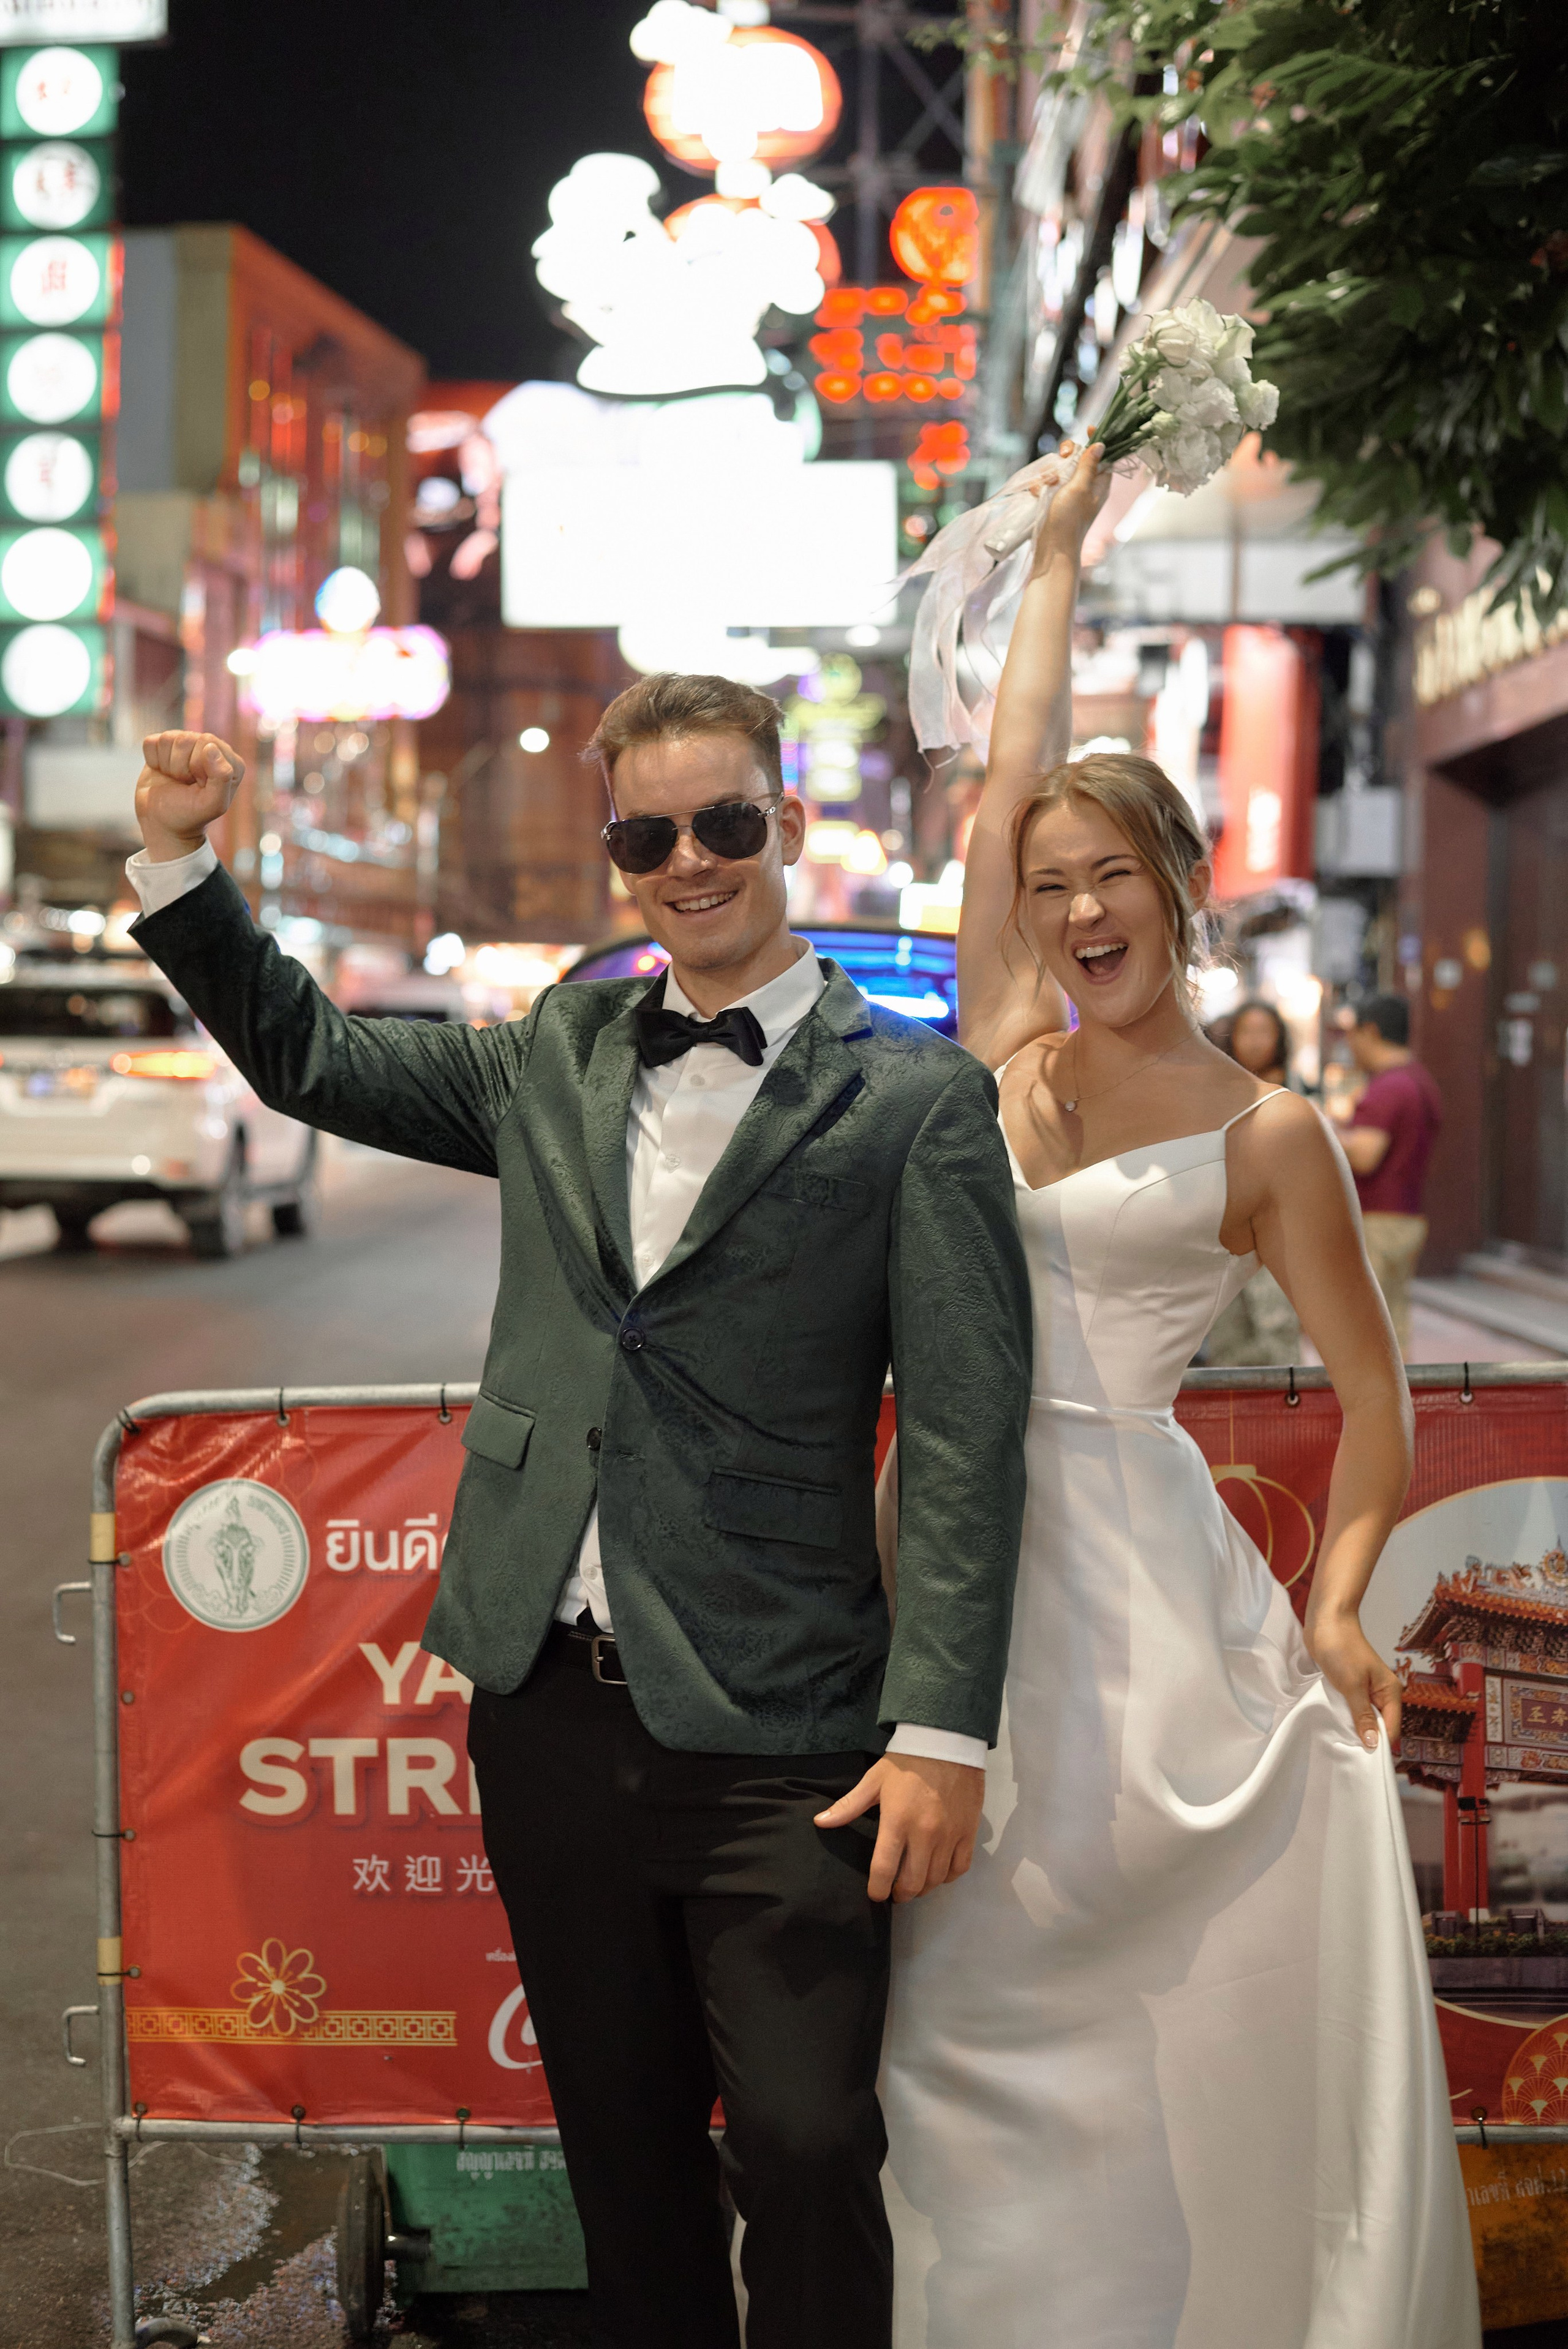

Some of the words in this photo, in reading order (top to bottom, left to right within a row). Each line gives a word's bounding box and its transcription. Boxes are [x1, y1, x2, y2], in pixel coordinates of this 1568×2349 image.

[326, 1513, 448, 1572] ยินดี
[239, 1737, 481, 1816] STR
[353, 1854, 495, 1892] 欢迎光
